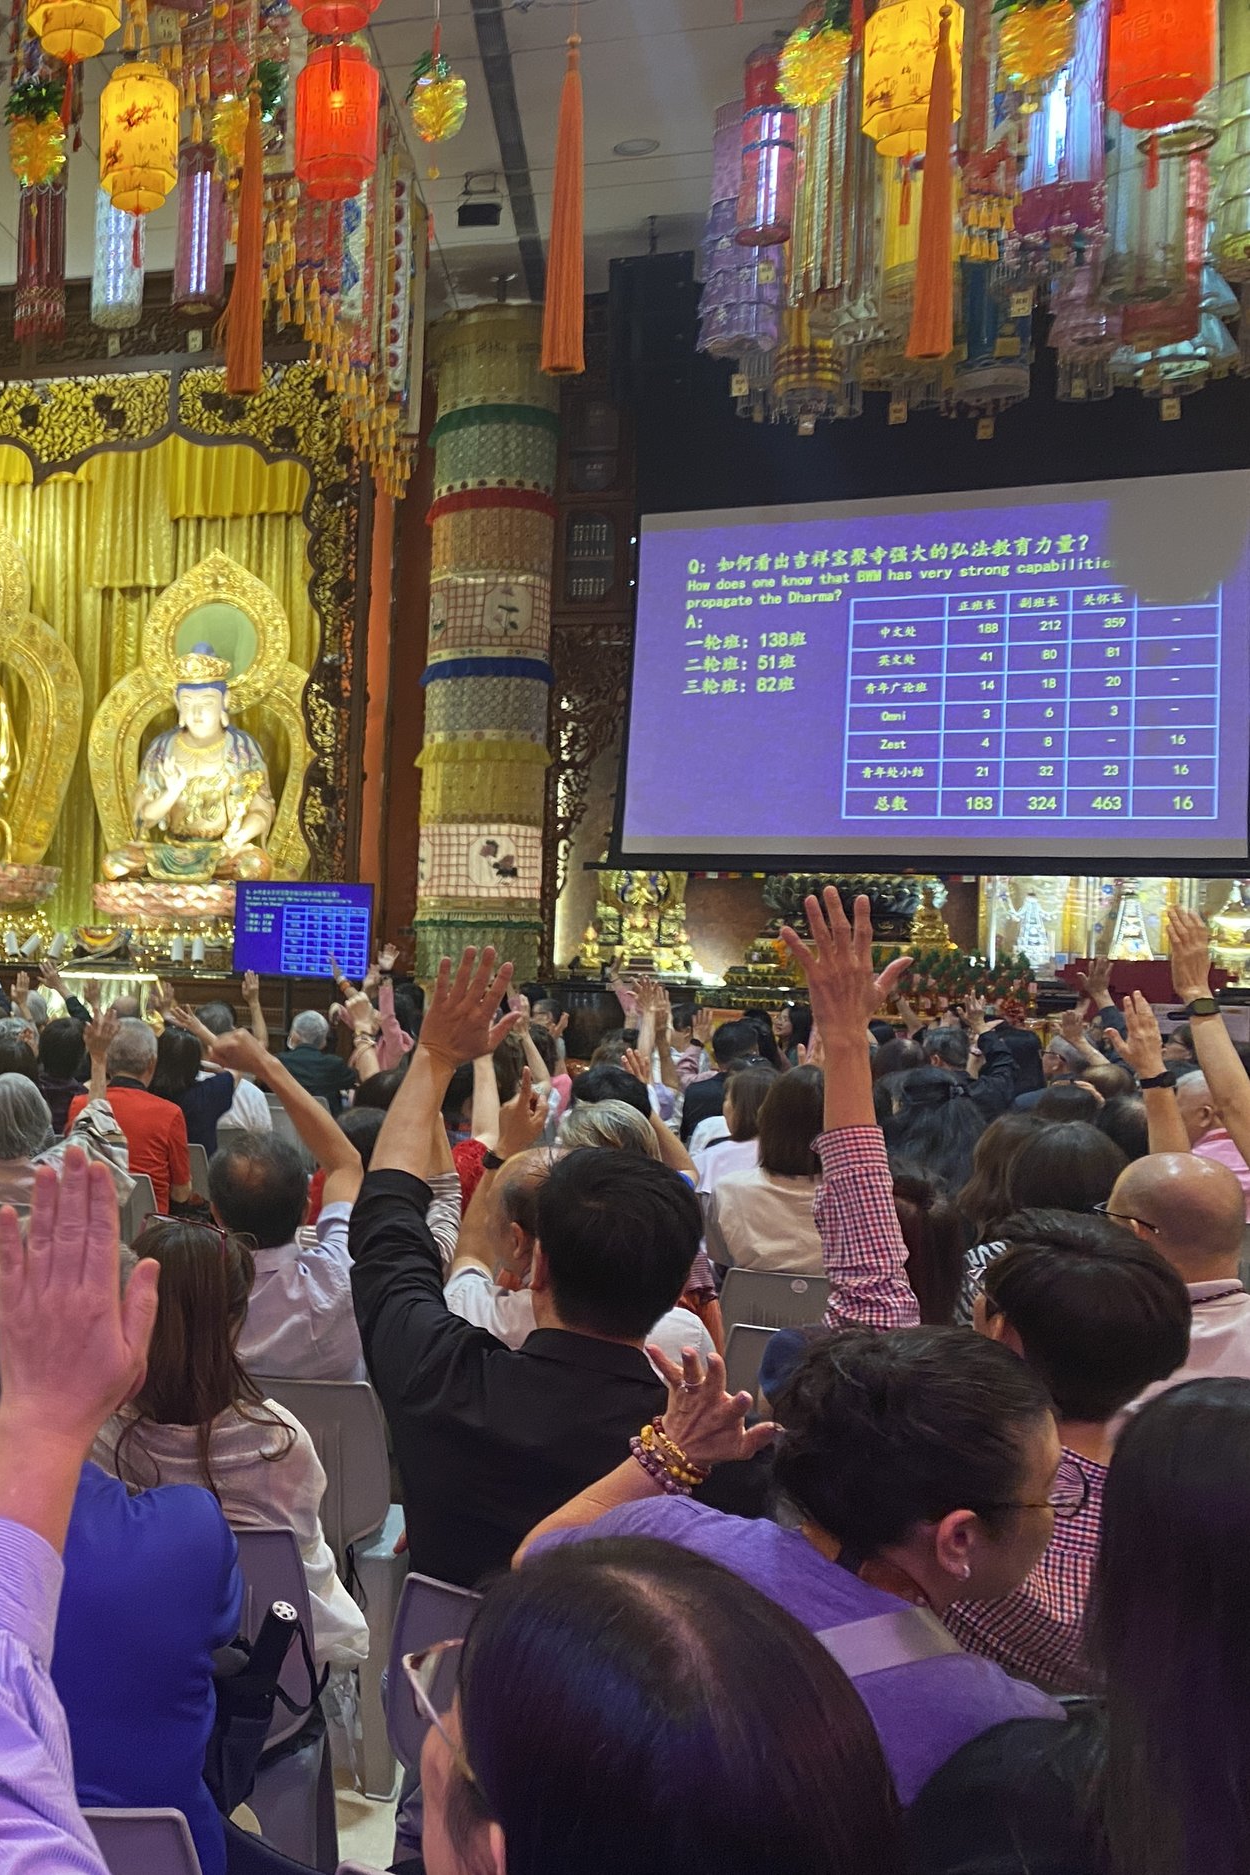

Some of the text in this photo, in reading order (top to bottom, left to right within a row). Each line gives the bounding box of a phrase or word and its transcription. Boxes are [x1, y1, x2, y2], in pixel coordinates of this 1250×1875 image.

[330, 100, 359, 127] 福
[687, 580, 710, 591] How
[716, 579, 745, 590] does
[752, 579, 775, 588] one
[782, 575, 813, 586] know
[819, 573, 849, 584] that
[888, 569, 912, 580] has
[920, 569, 952, 579] very
[960, 566, 1009, 577] strong
[686, 589, 842, 609] propagate the Dharma?
[881, 626, 916, 637] 中文处
[979, 623, 998, 633] 188
[1040, 620, 1061, 630] 212
[1104, 617, 1126, 628] 359
[879, 654, 915, 666] 英文处
[980, 652, 992, 661] 41
[1042, 649, 1057, 659] 80
[1106, 647, 1119, 657] 81
[981, 681, 994, 690] 14
[1042, 678, 1056, 688] 18
[1106, 676, 1121, 686] 20
[881, 711, 905, 721] Omni
[983, 709, 990, 719] 3
[1045, 708, 1053, 717] 6
[1110, 706, 1118, 716] 3
[880, 739, 906, 749] Zest
[981, 738, 989, 747] 4
[1044, 737, 1052, 746] 8
[1171, 735, 1186, 744] 16
[977, 767, 988, 776] 21
[1039, 766, 1053, 776] 32
[1104, 765, 1118, 775] 23
[1174, 765, 1189, 775] 16
[875, 796, 1193, 811] 总数 183 324 463 16
